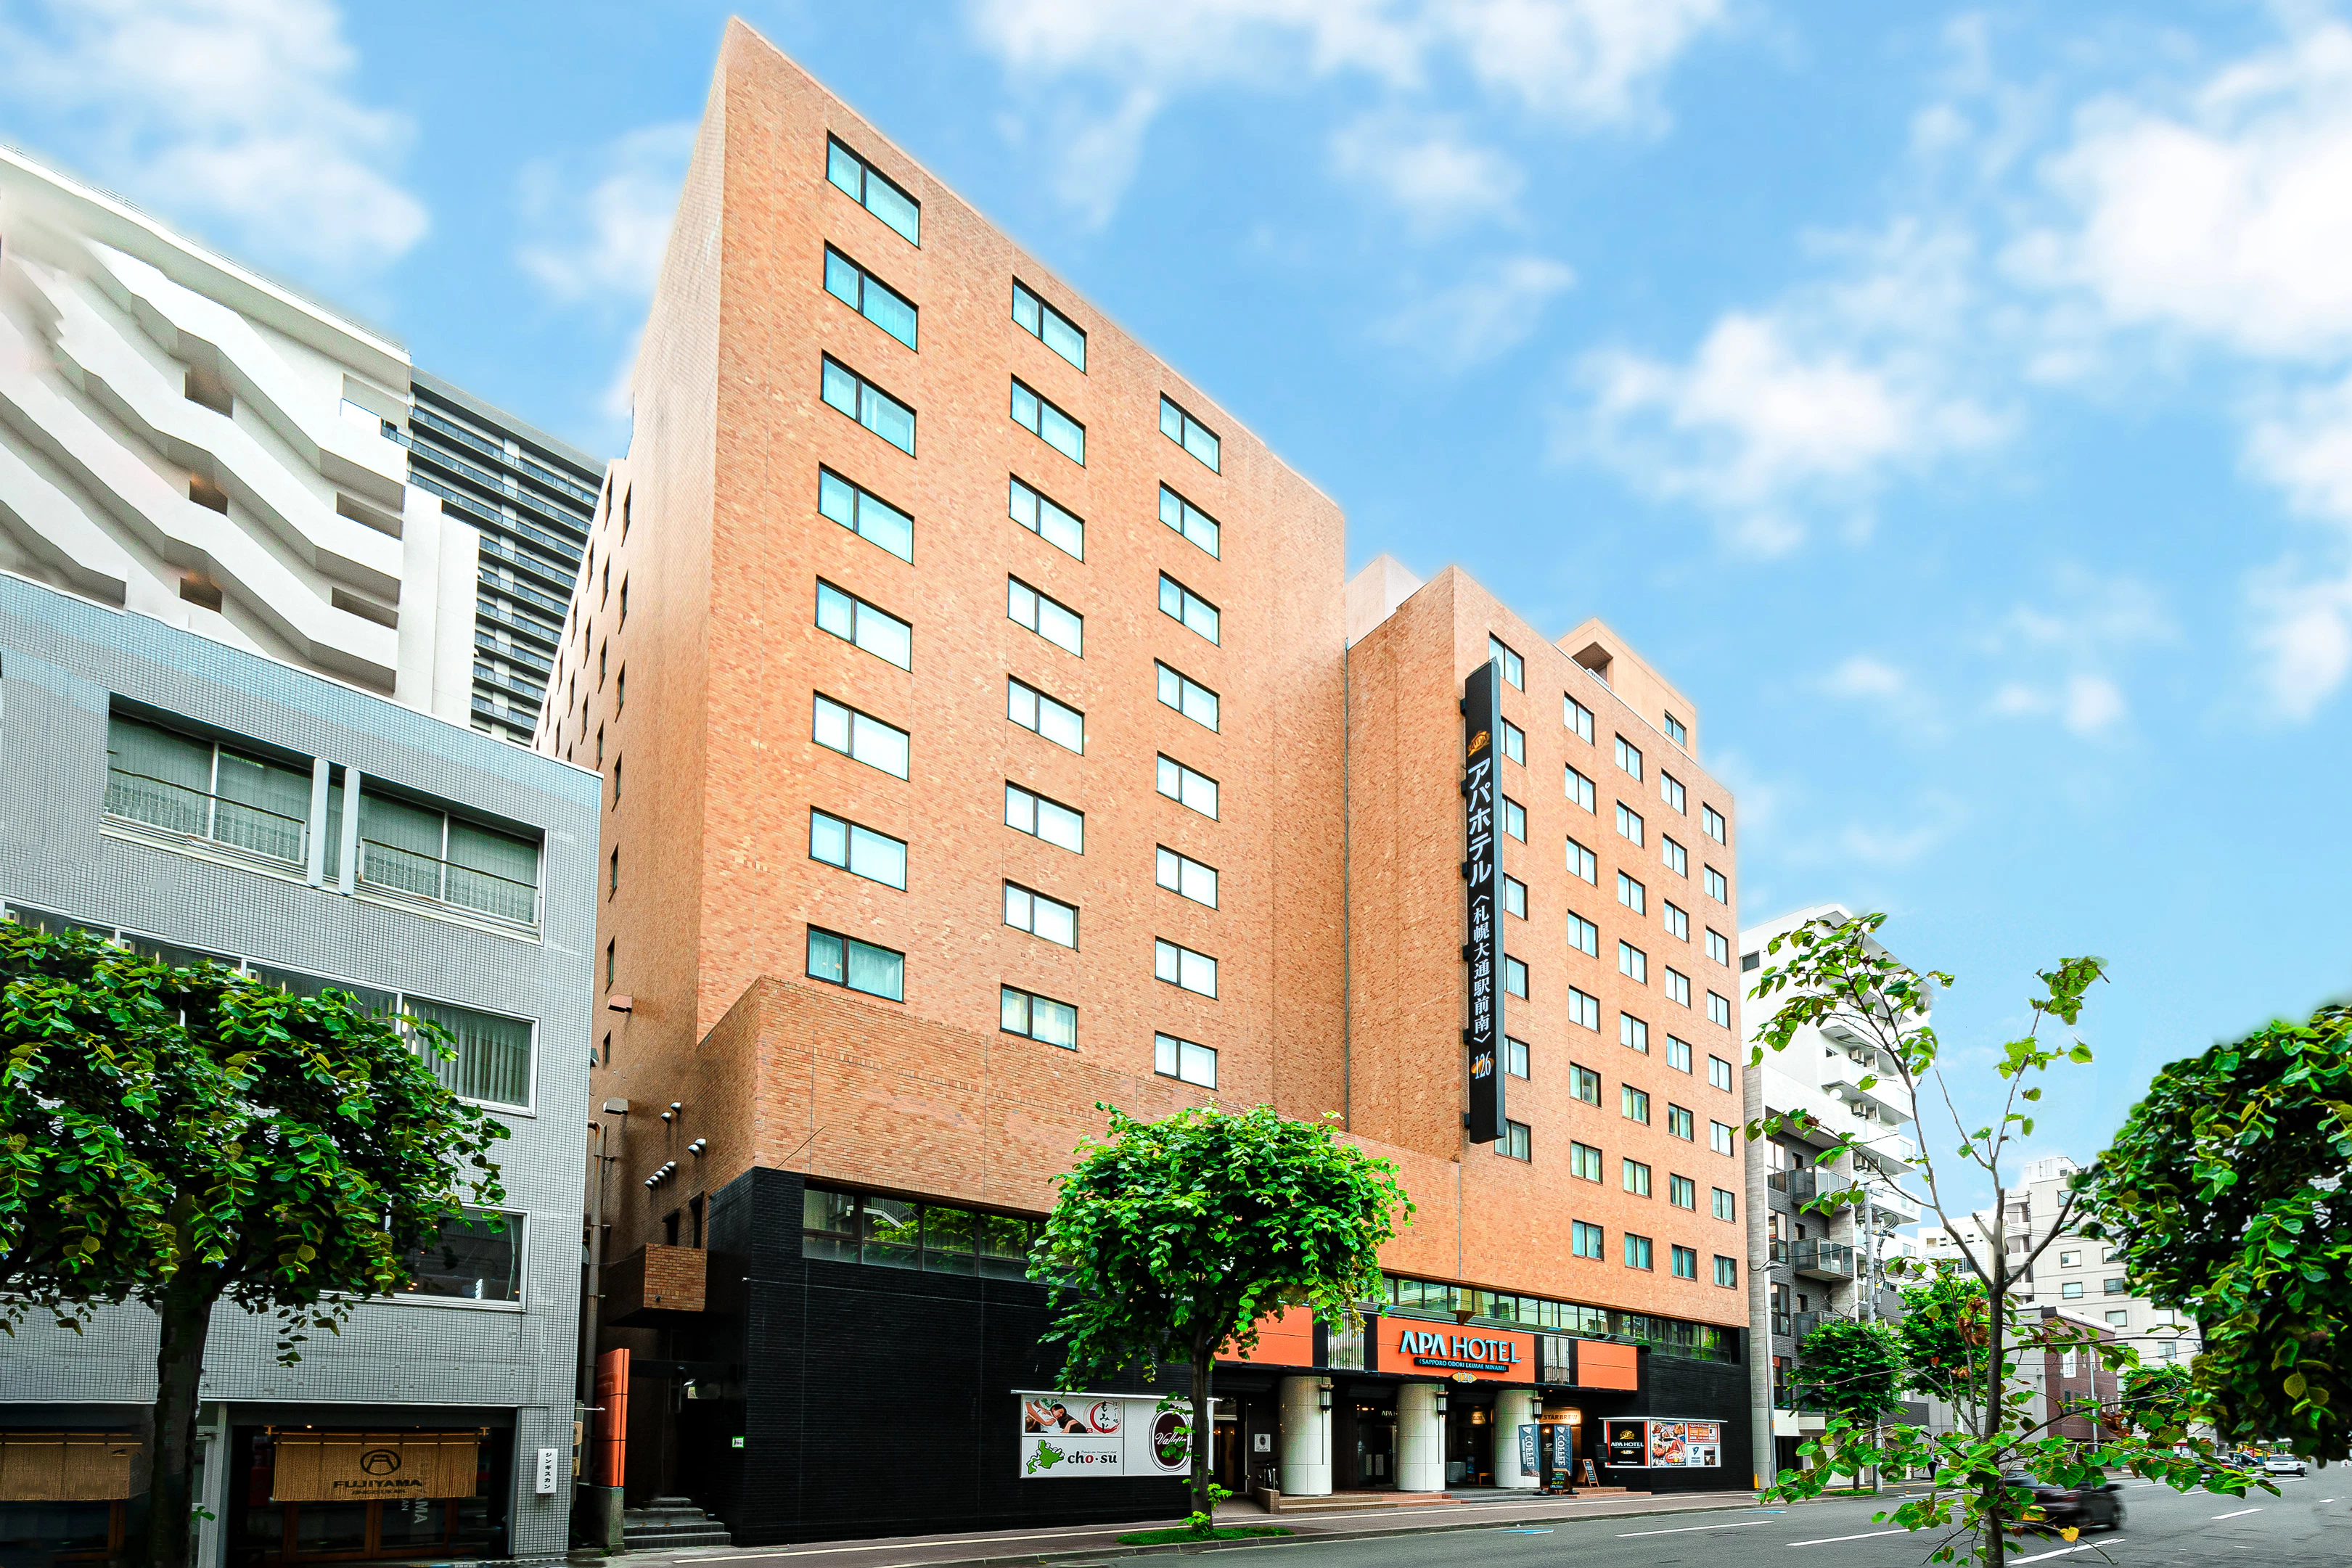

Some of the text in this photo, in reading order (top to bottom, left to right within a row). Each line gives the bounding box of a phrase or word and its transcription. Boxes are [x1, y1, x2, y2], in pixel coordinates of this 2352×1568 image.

[1467, 757, 1492, 887] アパホテル
[1475, 1050, 1491, 1080] 126
[1400, 1330, 1522, 1363] APA HOTEL
[1456, 1371, 1474, 1384] 126
[1525, 1435, 1535, 1467] COFFEE
[1557, 1434, 1566, 1466] COFFEE
[333, 1479, 423, 1488] FUJIYAMA
[544, 1452, 552, 1490] ジンギスカン
